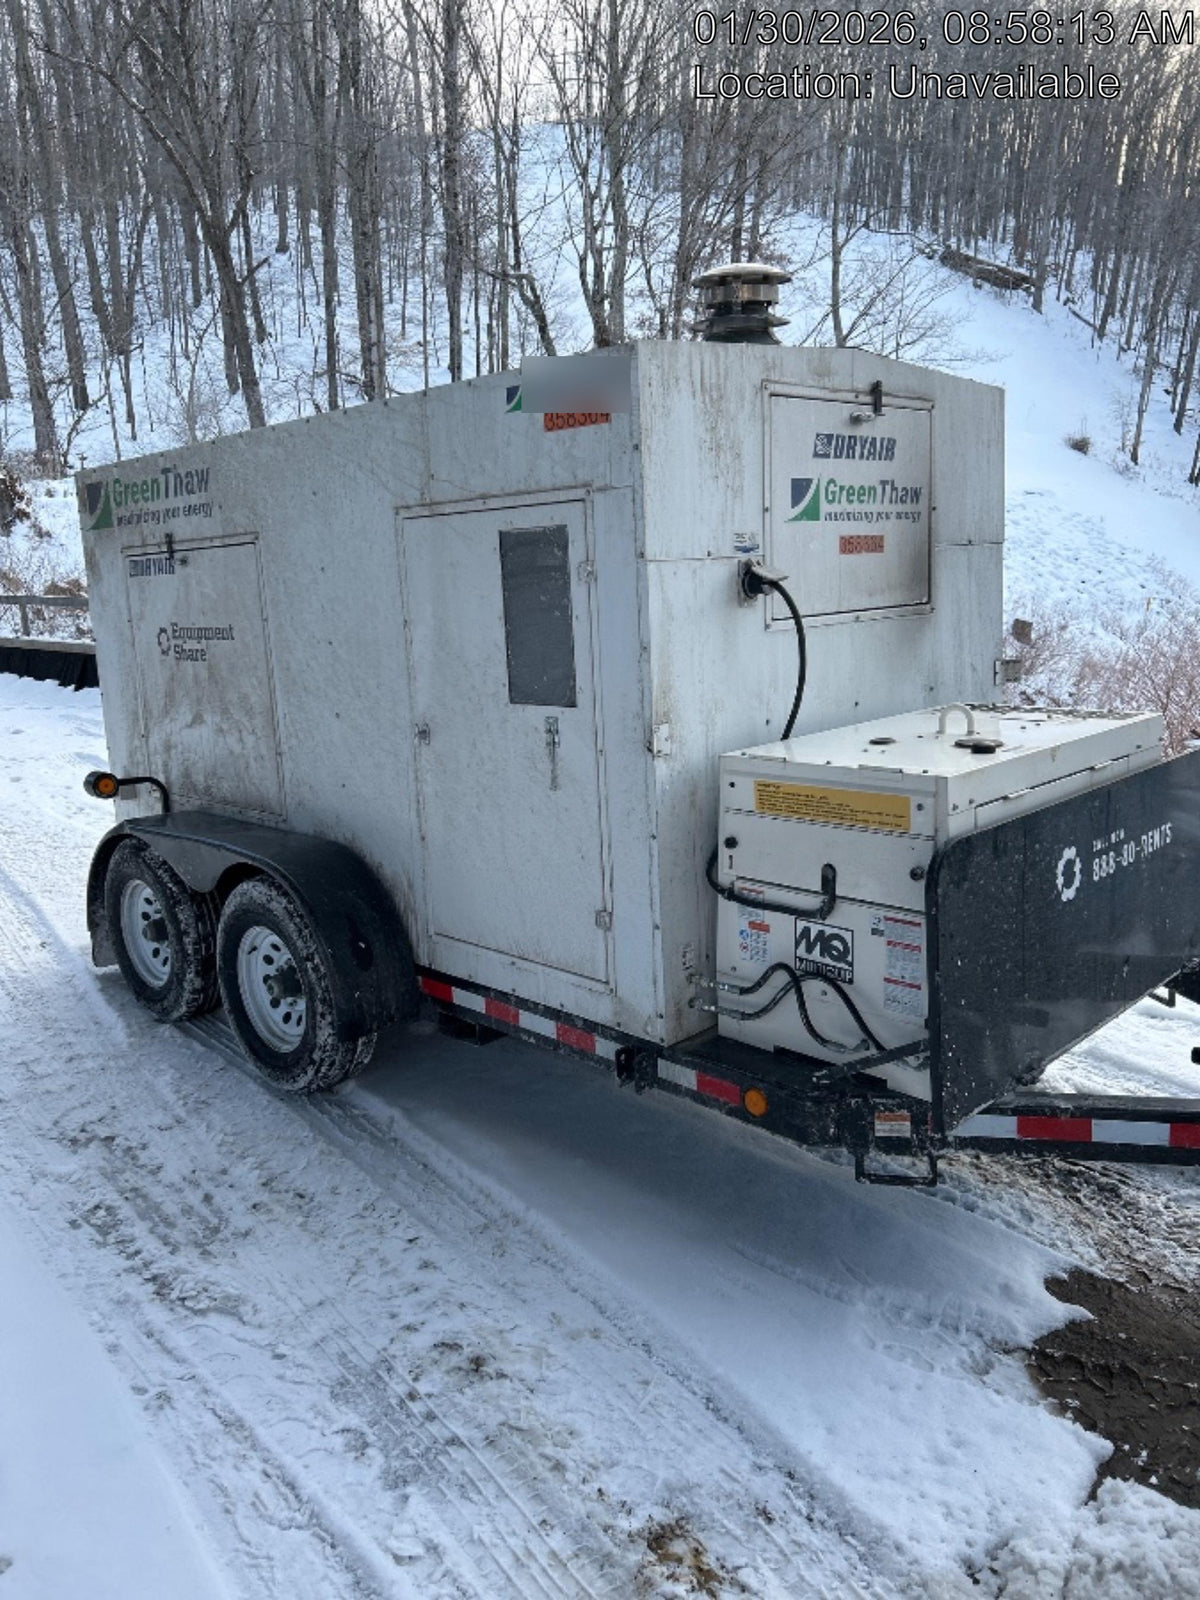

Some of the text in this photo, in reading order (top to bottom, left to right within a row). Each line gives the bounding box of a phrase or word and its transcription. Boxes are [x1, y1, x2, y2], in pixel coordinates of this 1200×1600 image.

[824, 477, 922, 505] GreenThaw
[170, 622, 236, 644] Equipment
[173, 644, 208, 662] Share
[796, 925, 853, 965] MQ
